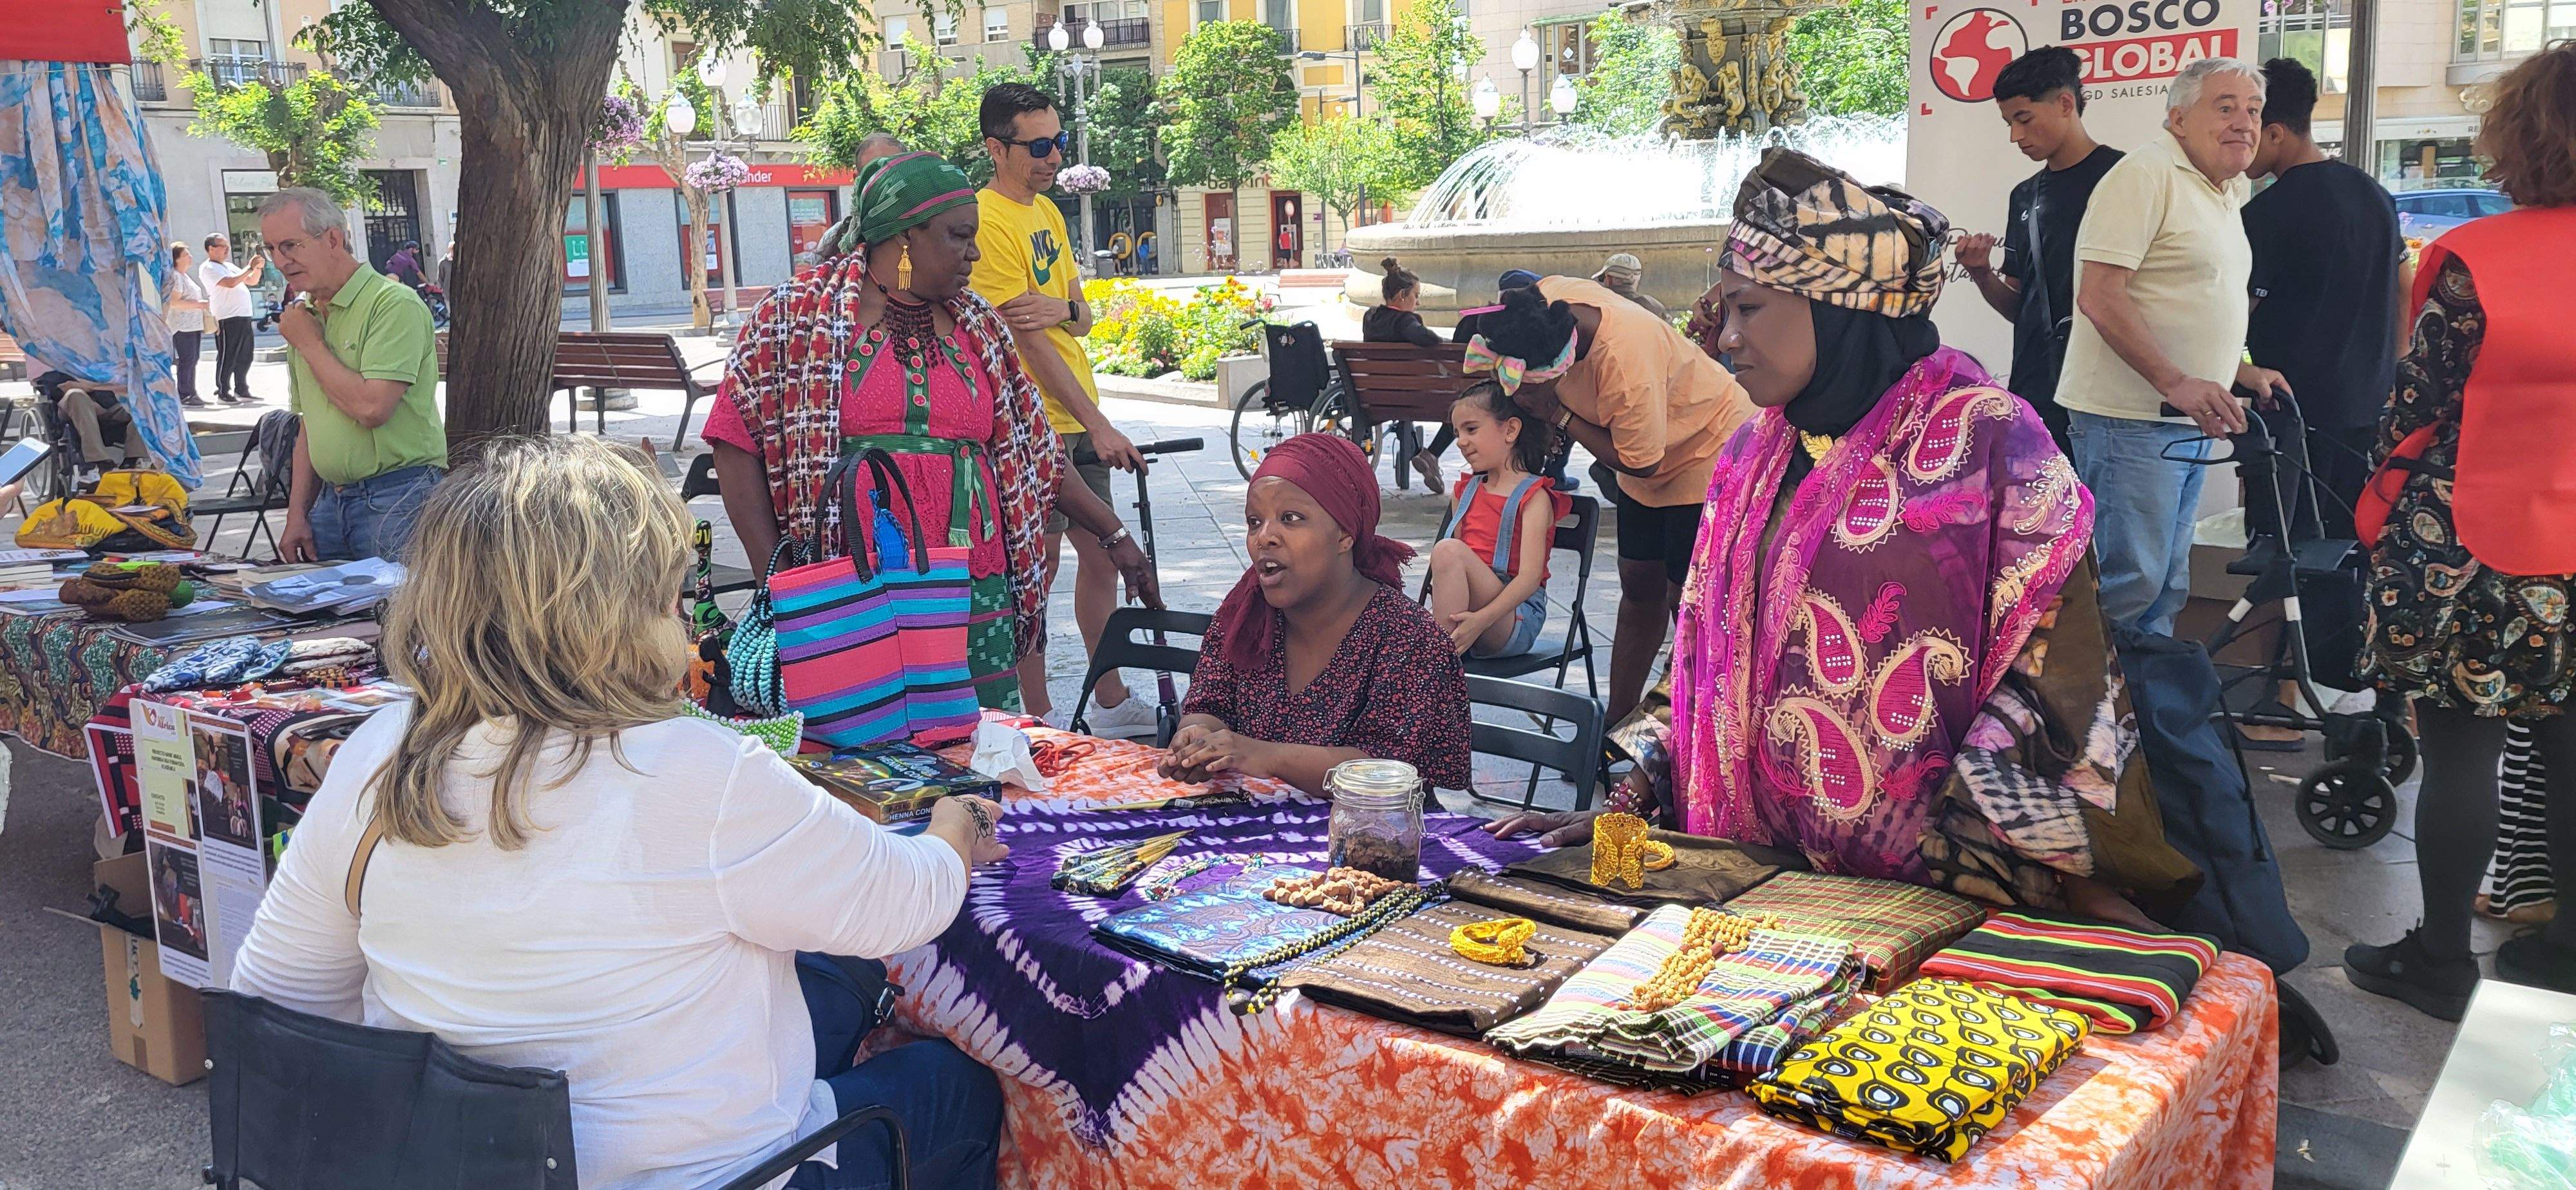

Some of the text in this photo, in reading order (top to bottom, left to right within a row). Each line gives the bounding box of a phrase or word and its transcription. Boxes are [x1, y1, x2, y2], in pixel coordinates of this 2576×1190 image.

[2061, 0, 2220, 41] BOSCO
[1029, 229, 1057, 261] NIKE
[876, 755, 908, 772] HENNA
[889, 811, 914, 821] HENNA
